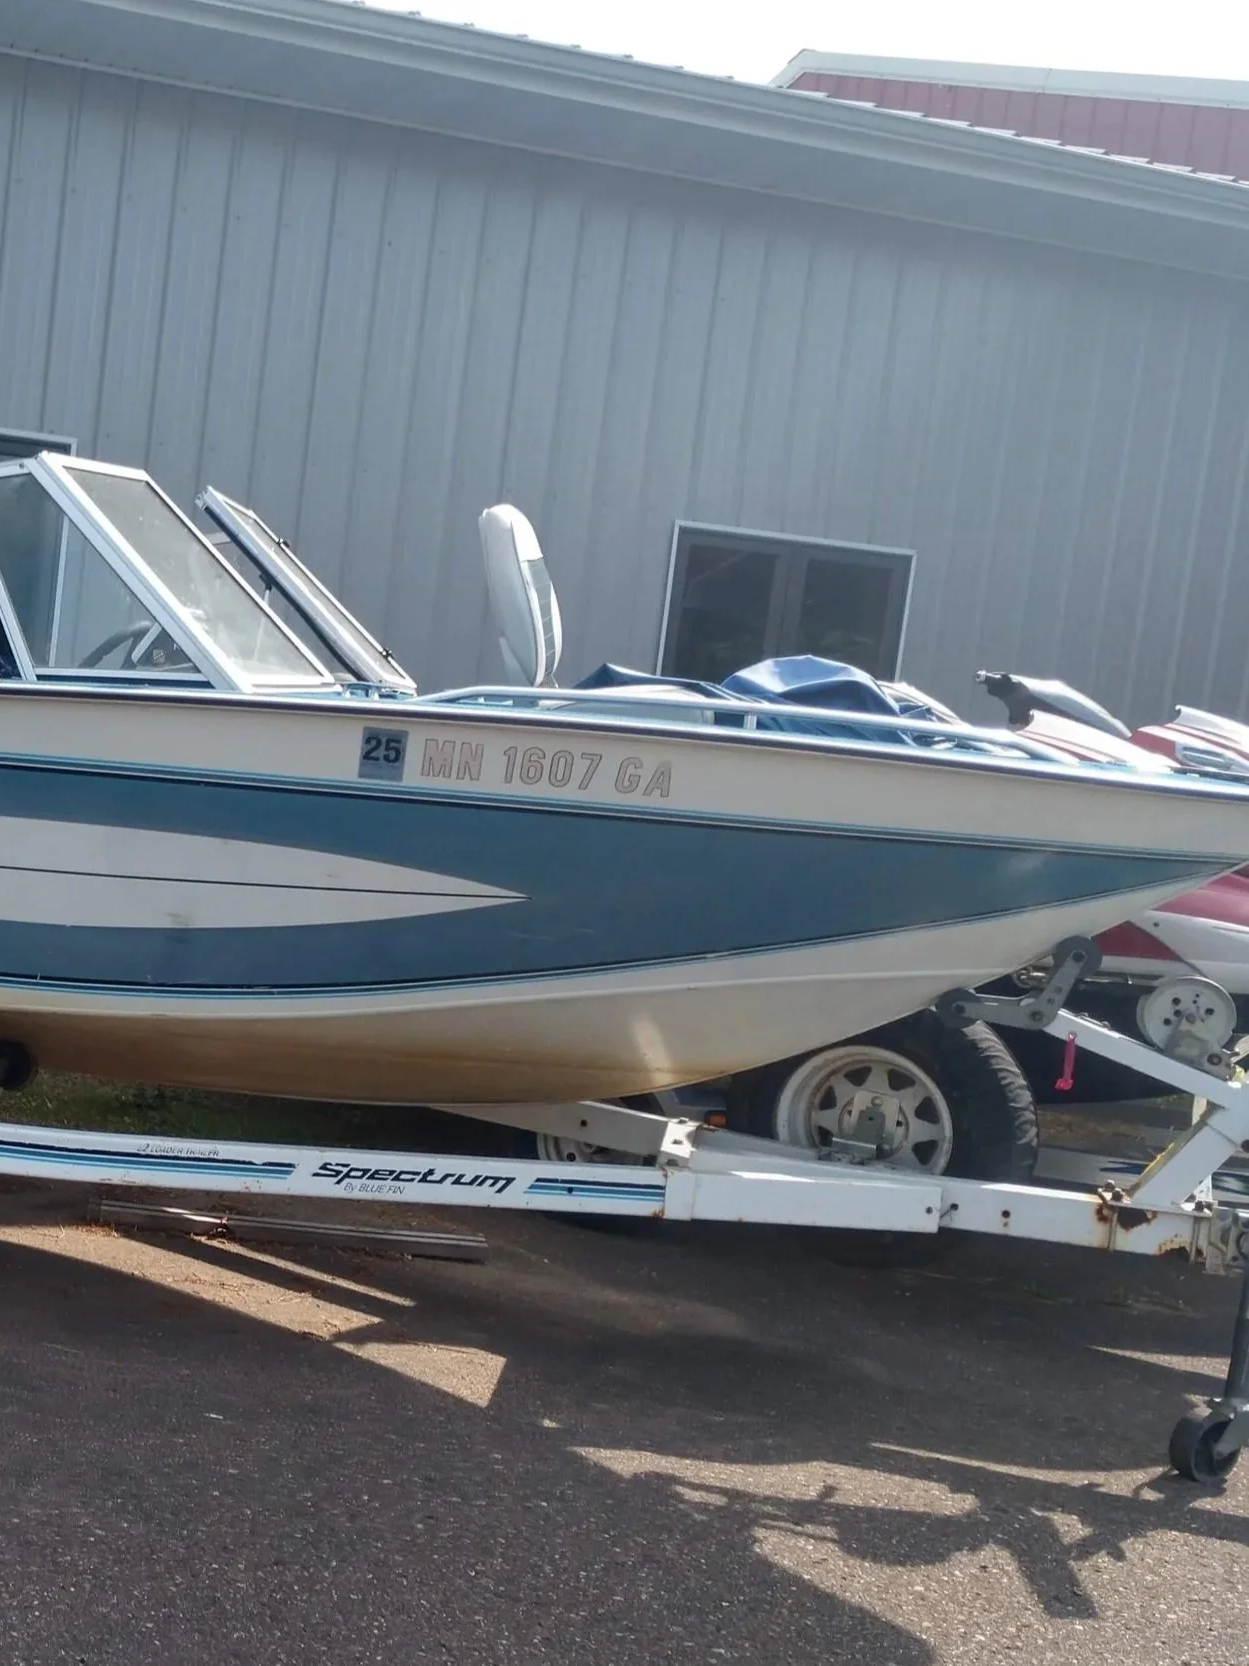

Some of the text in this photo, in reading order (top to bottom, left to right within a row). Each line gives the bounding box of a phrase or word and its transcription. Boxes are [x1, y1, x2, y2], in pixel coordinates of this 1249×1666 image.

[362, 736, 402, 763] 25
[420, 738, 673, 799] MN 1607 GA
[311, 1161, 517, 1194] Spectrum
[358, 1183, 387, 1195] BLUE
[386, 1185, 406, 1195] FIN
